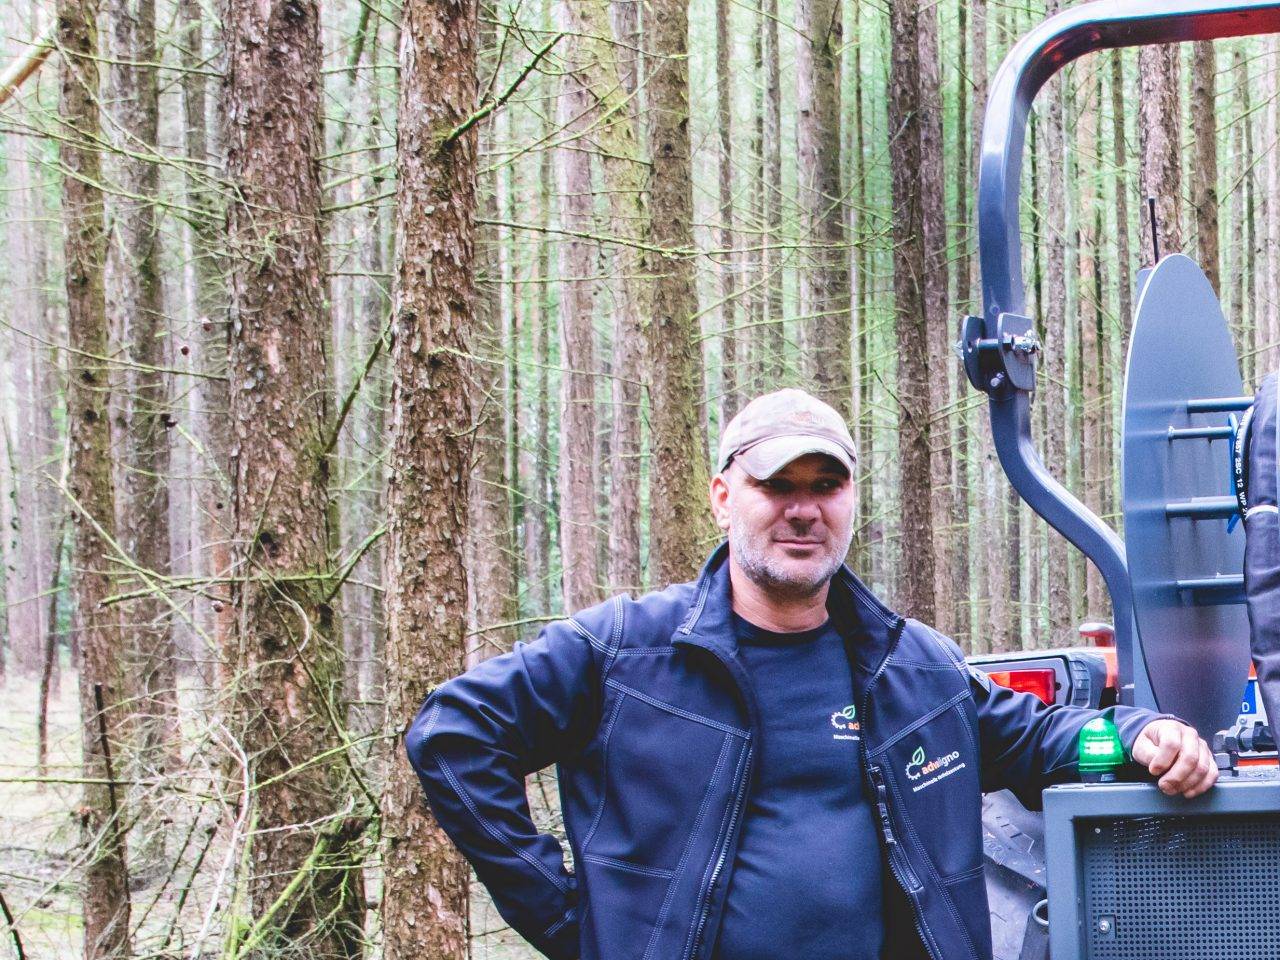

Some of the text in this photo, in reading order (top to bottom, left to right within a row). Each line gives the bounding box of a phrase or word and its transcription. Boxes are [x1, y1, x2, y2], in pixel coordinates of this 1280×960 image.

[1237, 478, 1244, 489] 12
[1239, 491, 1247, 506] WP
[1241, 701, 1250, 713] D
